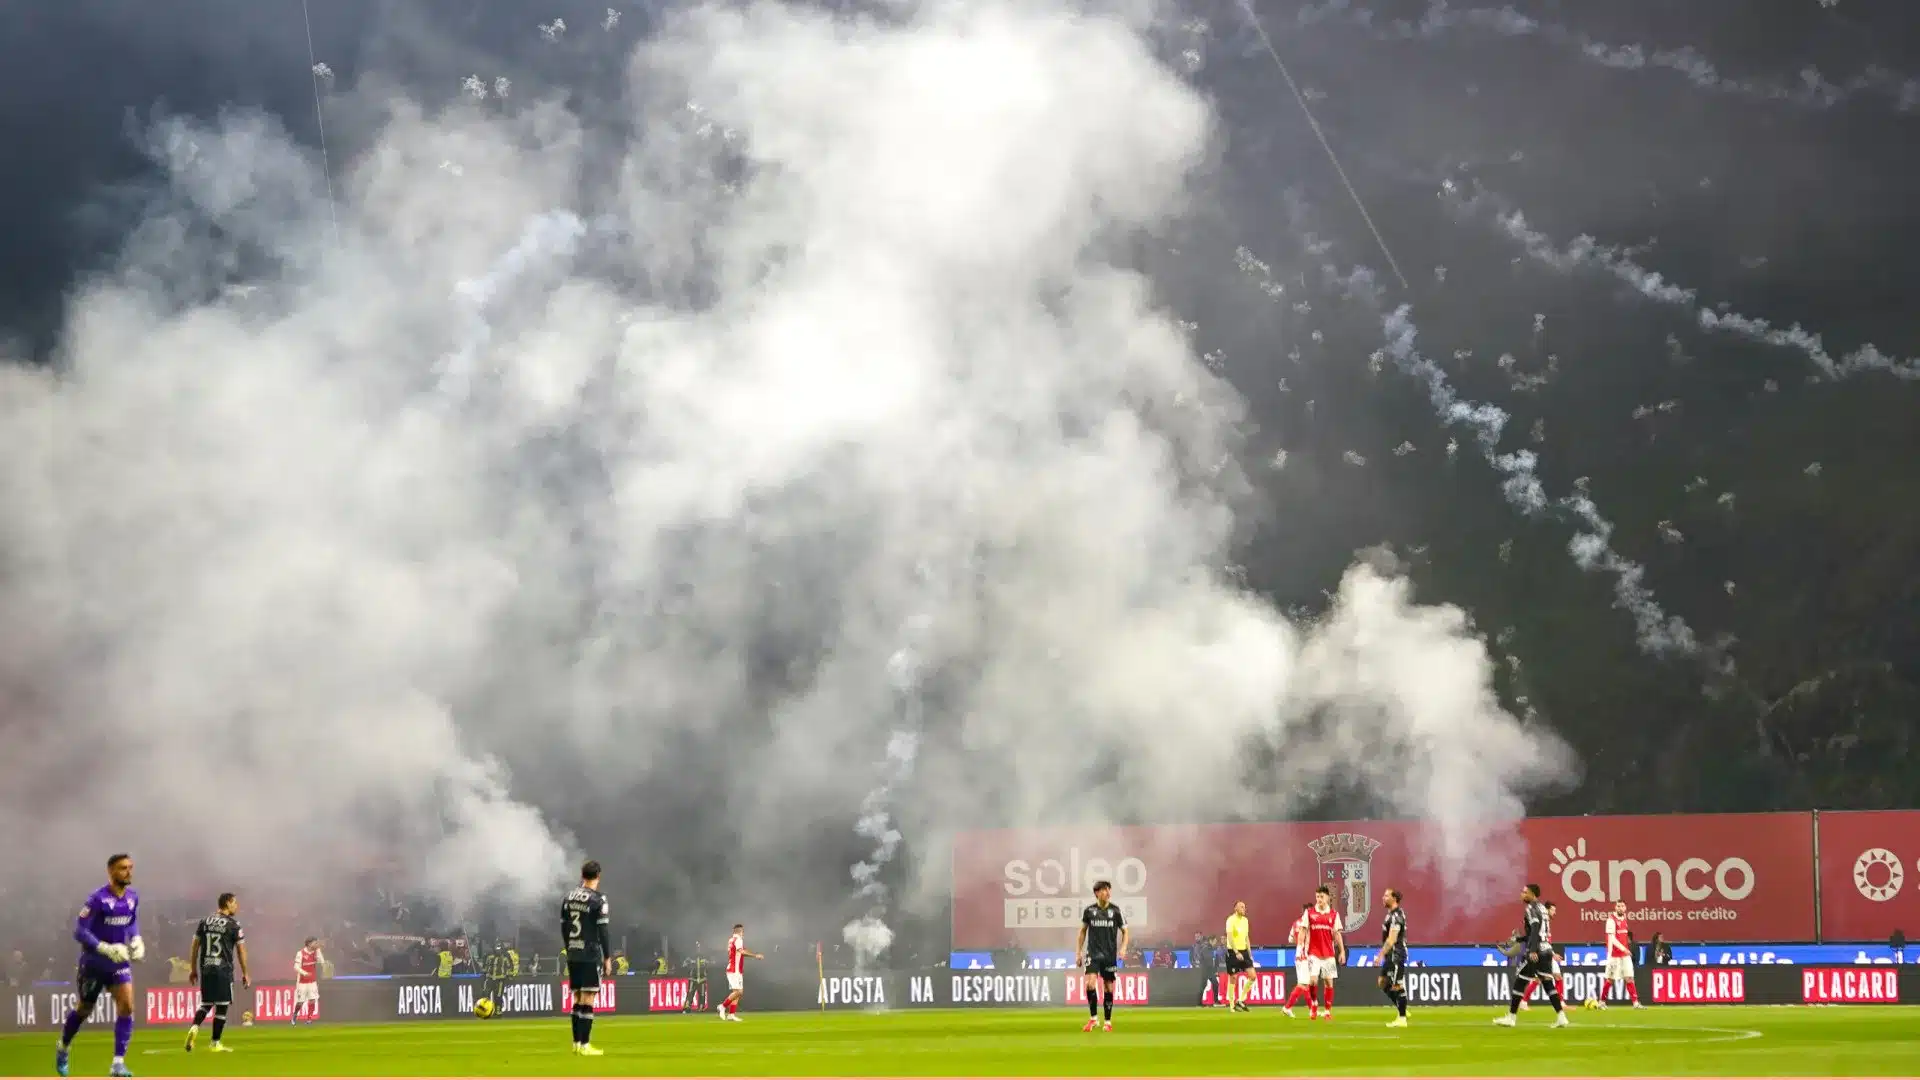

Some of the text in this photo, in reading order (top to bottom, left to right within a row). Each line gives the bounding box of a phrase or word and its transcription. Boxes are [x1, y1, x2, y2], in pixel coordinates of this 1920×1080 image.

[1004, 848, 1147, 895] soleo
[1561, 857, 1755, 902] amco
[569, 911, 581, 938] 3
[1017, 901, 1134, 924] piscis
[1581, 907, 1738, 921] interediários crédito
[206, 933, 222, 957] 13
[818, 975, 1051, 1003] APOSTA NA DESPORTIVA
[1487, 972, 1511, 1000] NA
[1653, 971, 1743, 998] PLACARD
[1803, 971, 1897, 998] PLACARD
[17, 995, 36, 1025] NA
[398, 984, 553, 1014] APOSTA NA SPORTIVA
